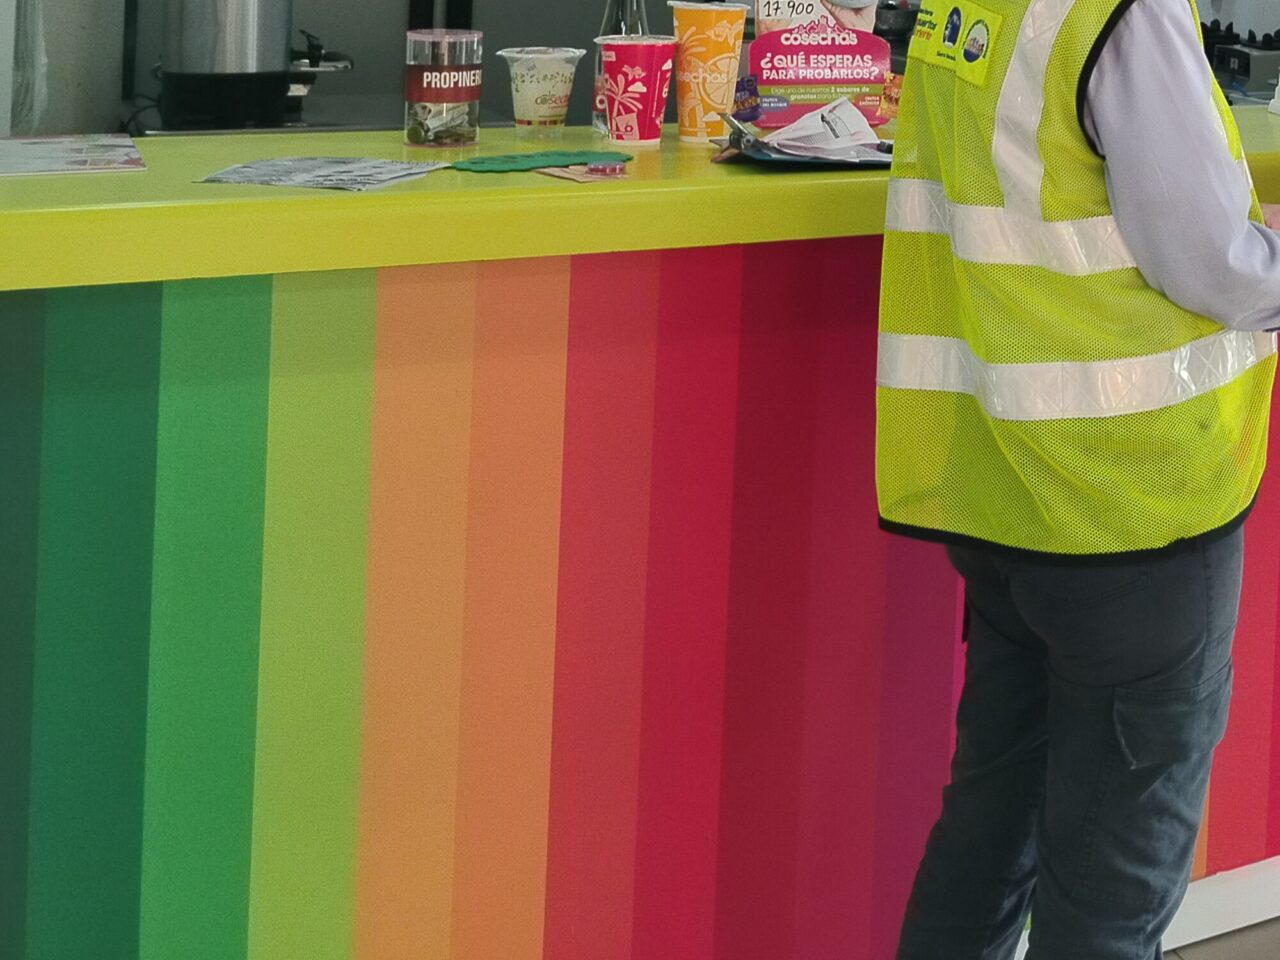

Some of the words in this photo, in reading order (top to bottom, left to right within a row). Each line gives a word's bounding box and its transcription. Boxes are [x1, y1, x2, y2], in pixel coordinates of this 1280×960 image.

[764, 0, 814, 17] 17.900
[781, 32, 858, 45] cosechas
[810, 54, 872, 68] ESPERAS
[762, 70, 795, 80] PARA
[799, 67, 879, 80] PROBARLOS?
